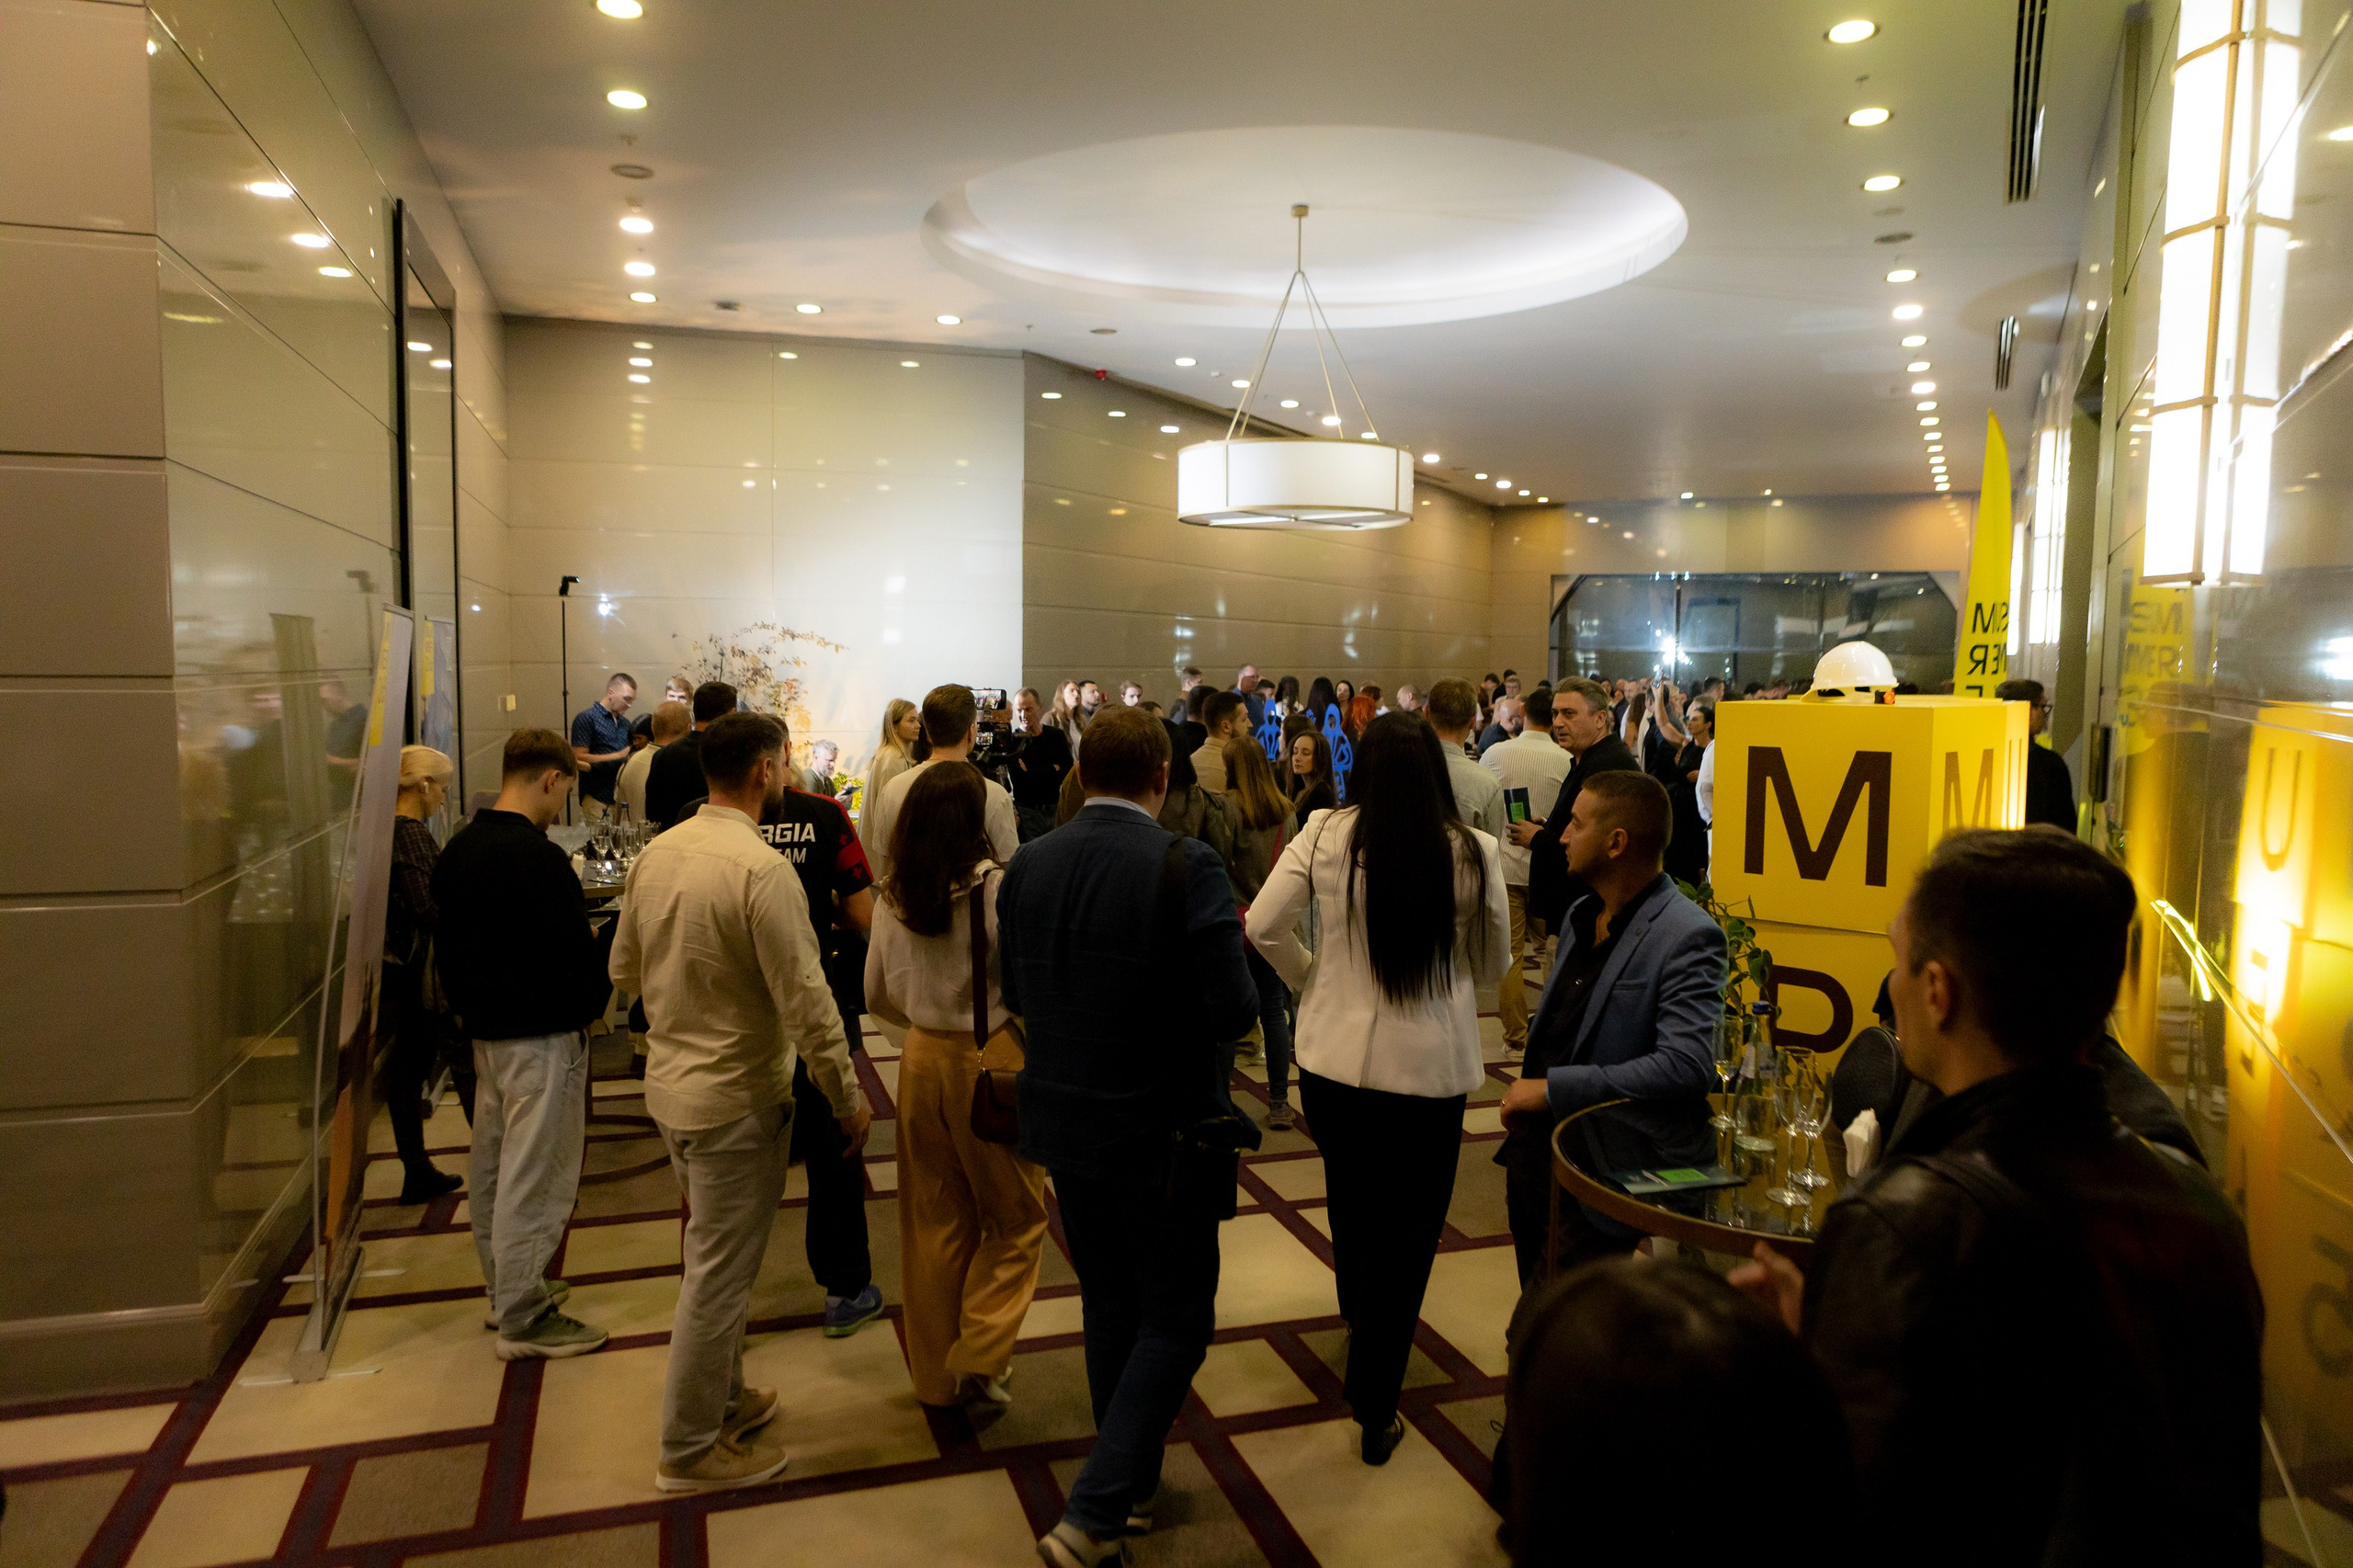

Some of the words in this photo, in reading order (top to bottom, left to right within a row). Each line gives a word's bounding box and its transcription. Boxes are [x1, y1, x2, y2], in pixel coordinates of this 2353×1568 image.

[1744, 745, 1893, 888] M
[1943, 747, 1995, 831] M
[776, 847, 807, 864] AM
